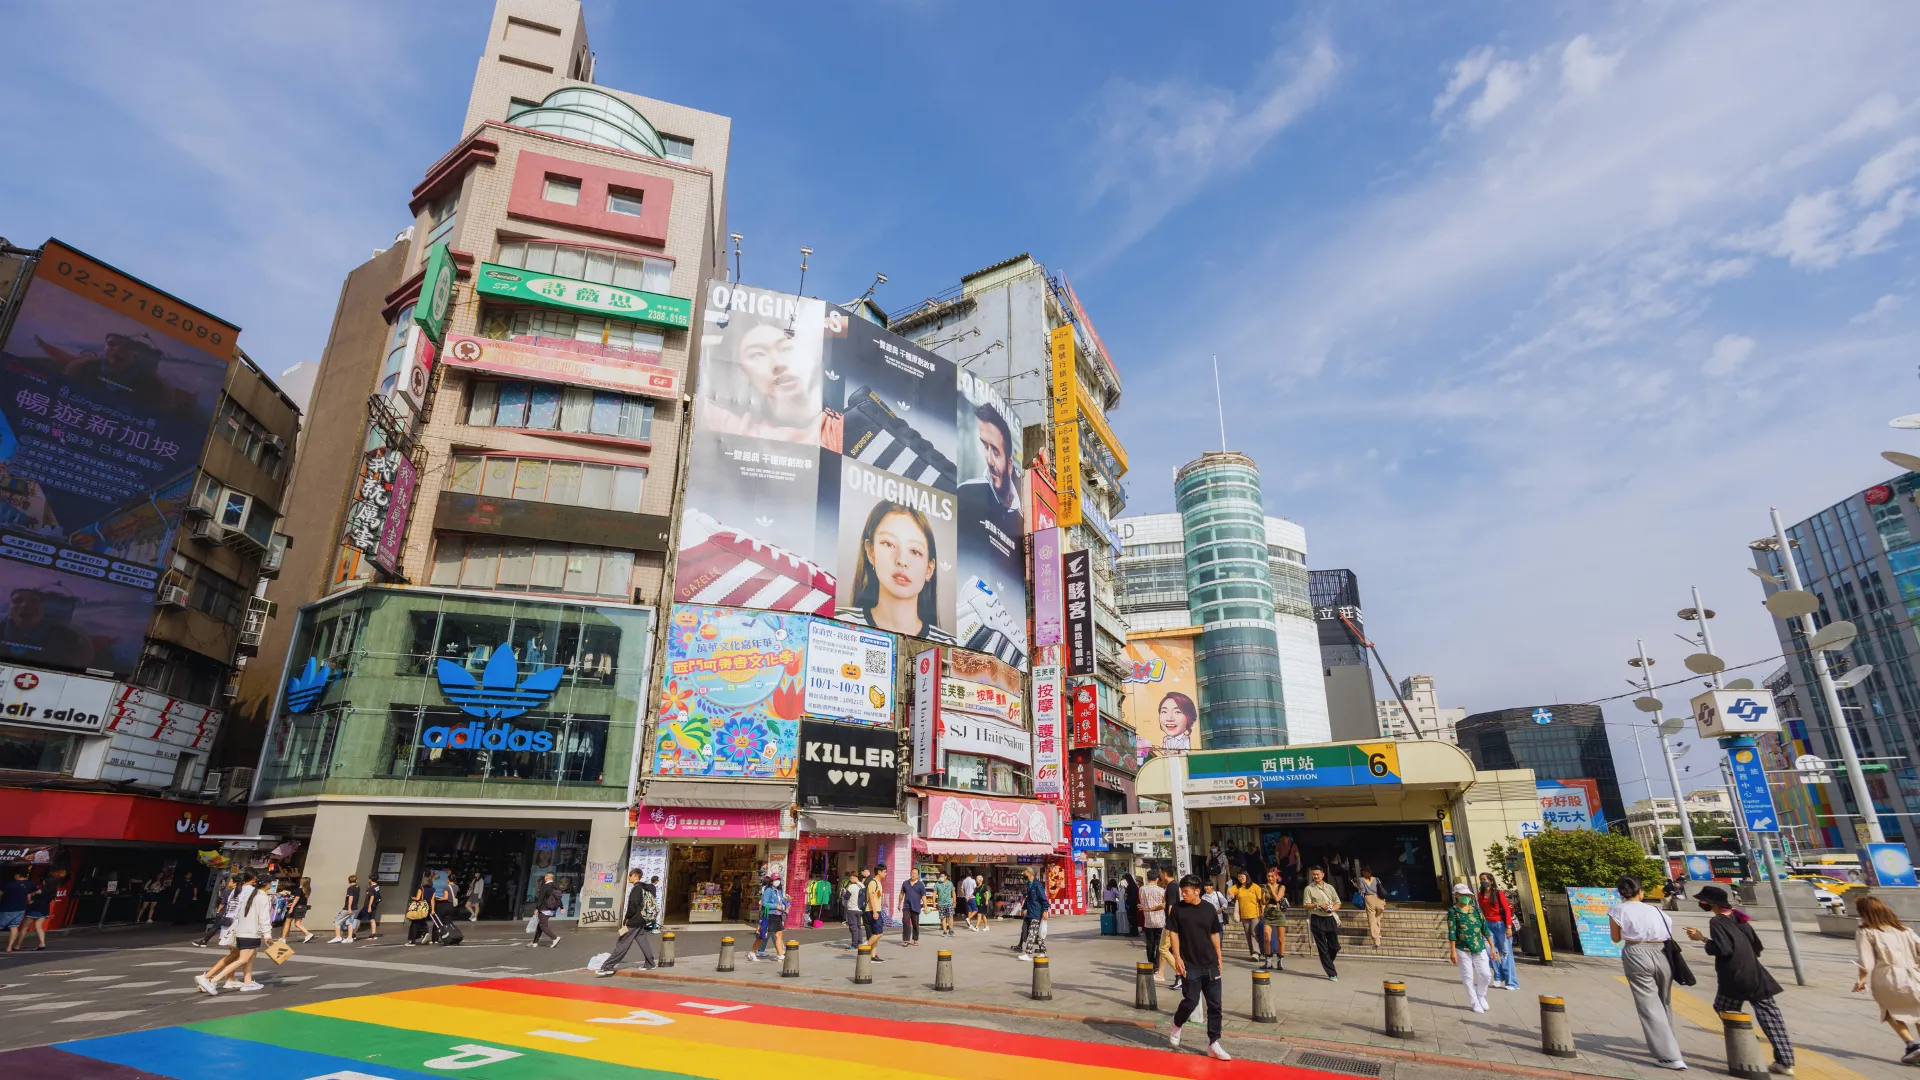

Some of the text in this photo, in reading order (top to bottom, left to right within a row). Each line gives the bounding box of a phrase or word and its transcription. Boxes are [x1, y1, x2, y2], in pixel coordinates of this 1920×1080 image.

[492, 283, 517, 292] SPA
[57, 261, 222, 346] 02-27182099
[647, 309, 687, 325] 2388-8155
[652, 377, 669, 387] 6F
[963, 372, 1021, 436] ORIGINALS
[16, 388, 180, 462] 暢遊新加坡
[850, 430, 874, 457] SUPERSTAR
[849, 464, 953, 521] ORIGINALS
[681, 566, 721, 598] GAZELLE
[1041, 564, 1052, 601] 湯の花
[1067, 581, 1087, 620] 駭客
[961, 621, 979, 642] SAMBA
[673, 650, 796, 674] 西門町青春文化季
[810, 676, 865, 696] 10/1~10/31
[976, 689, 994, 701] 按摩
[1037, 684, 1054, 713] 按摩
[43, 708, 99, 725] salon
[422, 721, 554, 753] adidas
[976, 727, 1004, 745] Hair
[1004, 735, 1024, 752] Salon
[805, 741, 895, 769] KILLER
[1261, 756, 1315, 774] 西門站
[1369, 753, 1388, 777] 6
[859, 772, 870, 786] 7
[1286, 773, 1318, 781] STATION
[1736, 765, 1752, 798] 服務中心
[1540, 796, 1583, 808] 存好股
[1436, 809, 1446, 820] 6
[1543, 811, 1587, 823] 找元大
